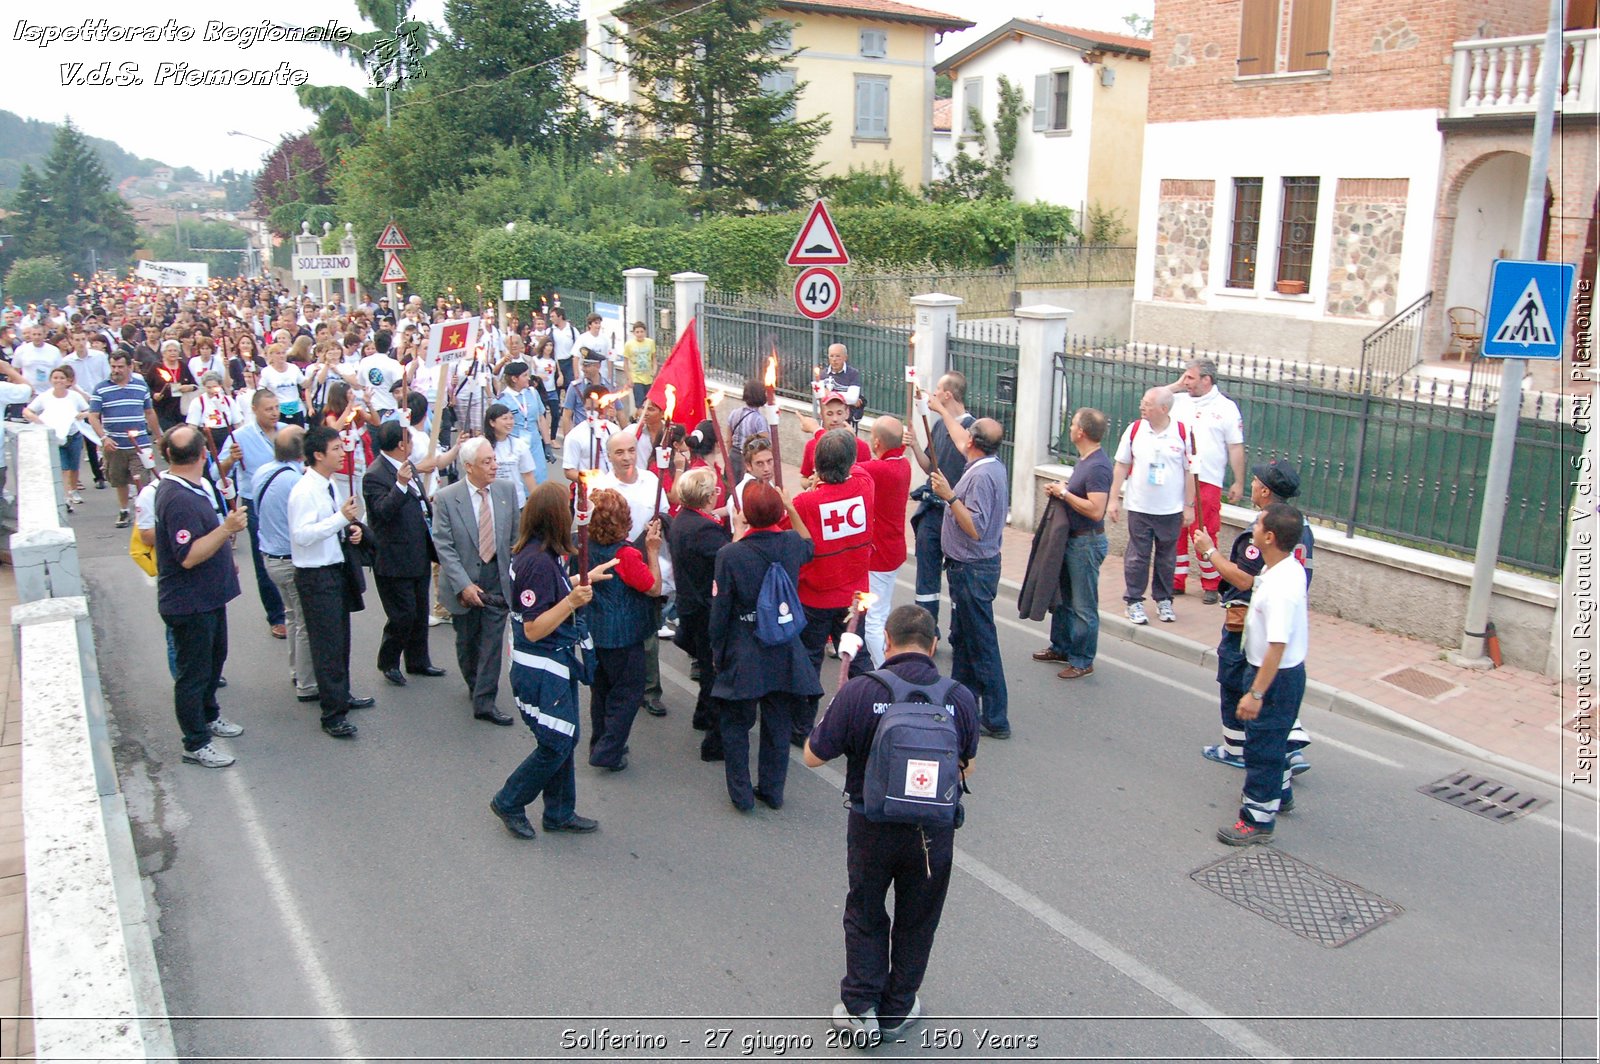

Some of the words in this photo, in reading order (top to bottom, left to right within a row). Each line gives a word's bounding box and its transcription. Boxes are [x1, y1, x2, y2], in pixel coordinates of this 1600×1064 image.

[144, 263, 187, 277] TOLENTINO
[298, 256, 351, 270] SOLFERINO
[805, 281, 831, 305] 40
[442, 353, 454, 362] VIET
